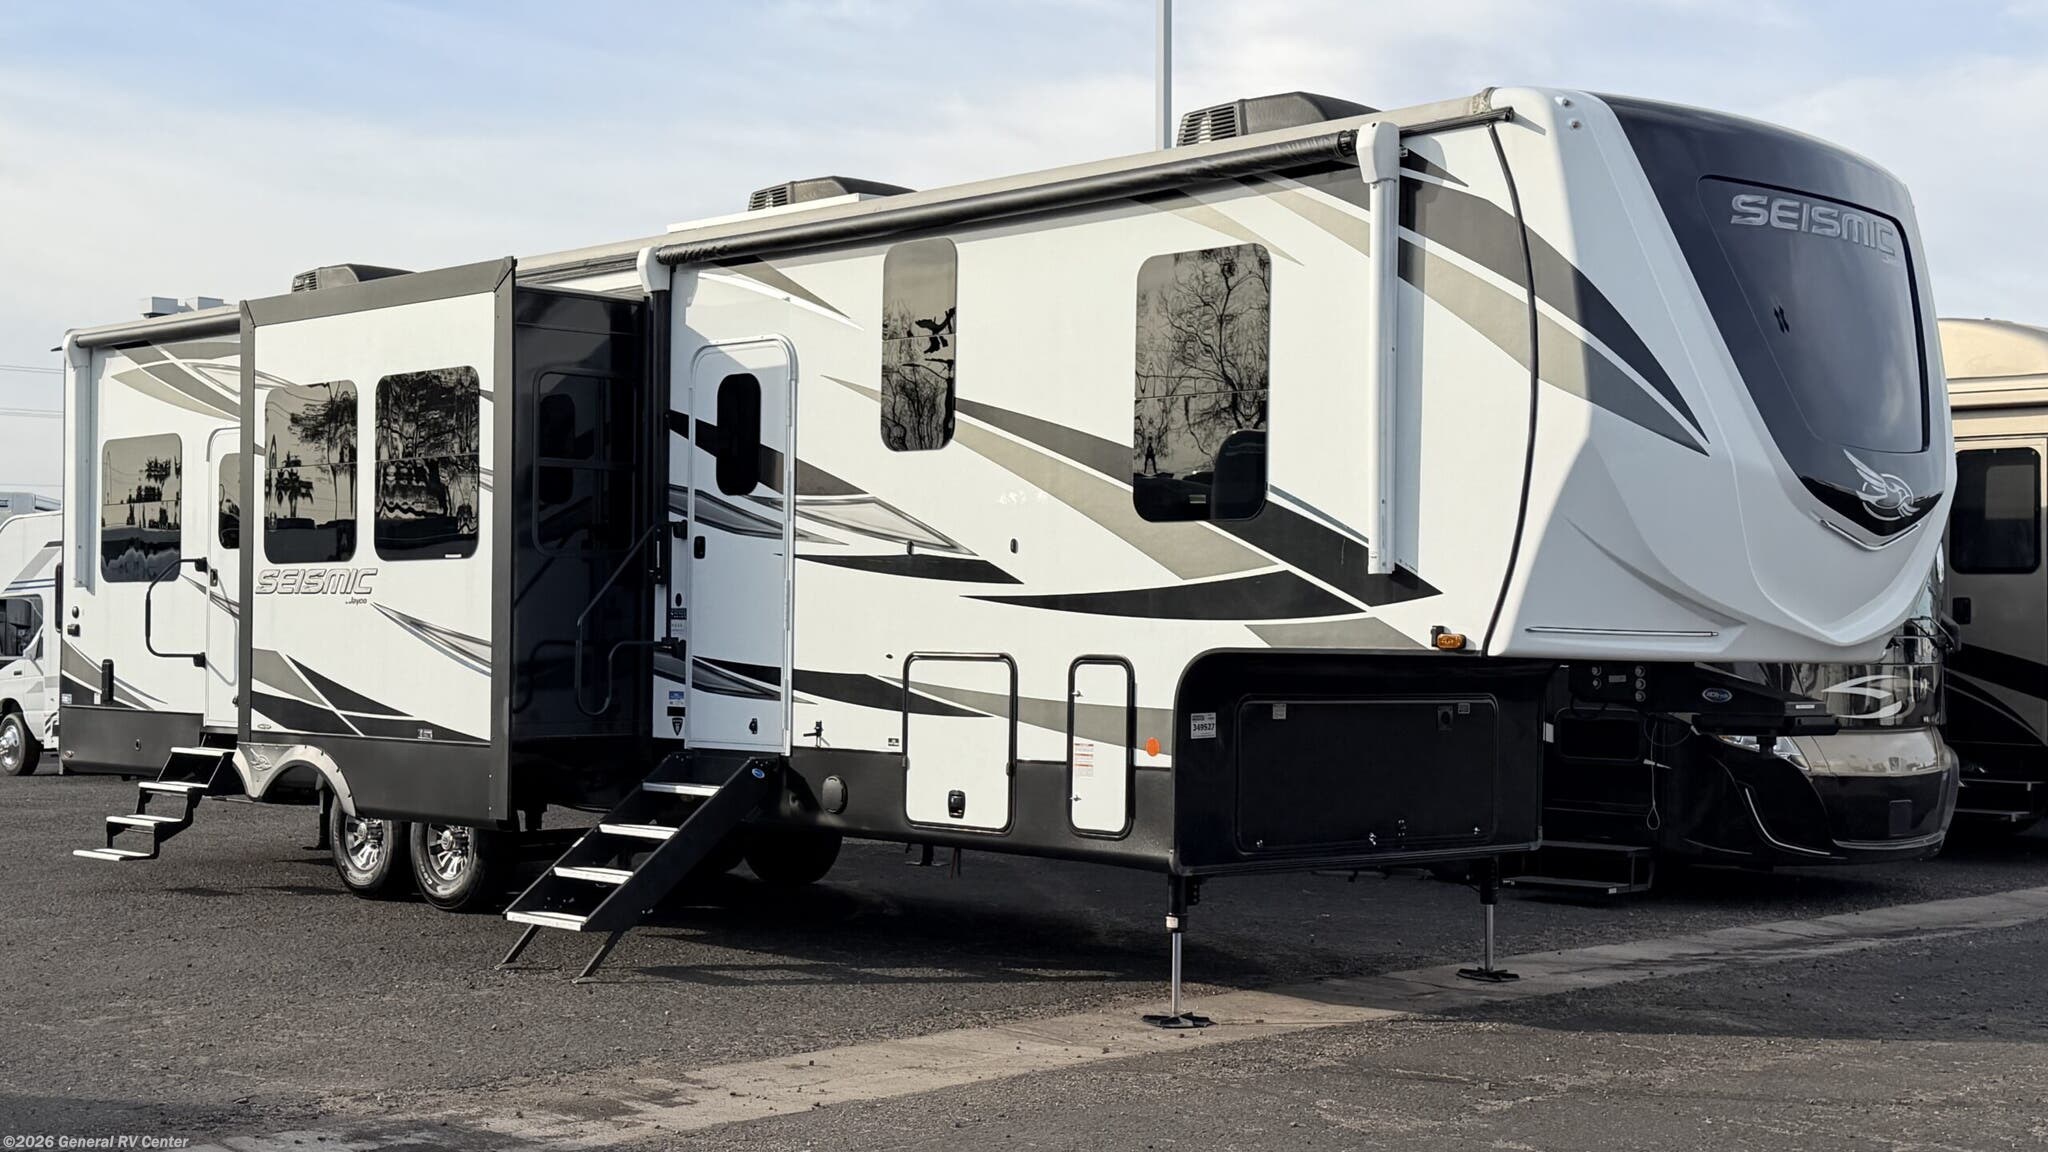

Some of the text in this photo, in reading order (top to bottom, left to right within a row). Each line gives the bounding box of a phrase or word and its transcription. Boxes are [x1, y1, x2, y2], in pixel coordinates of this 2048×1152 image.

[1730, 194, 1895, 256] SEISMIC
[255, 568, 378, 595] SEISMIC
[349, 596, 368, 606] Jayco
